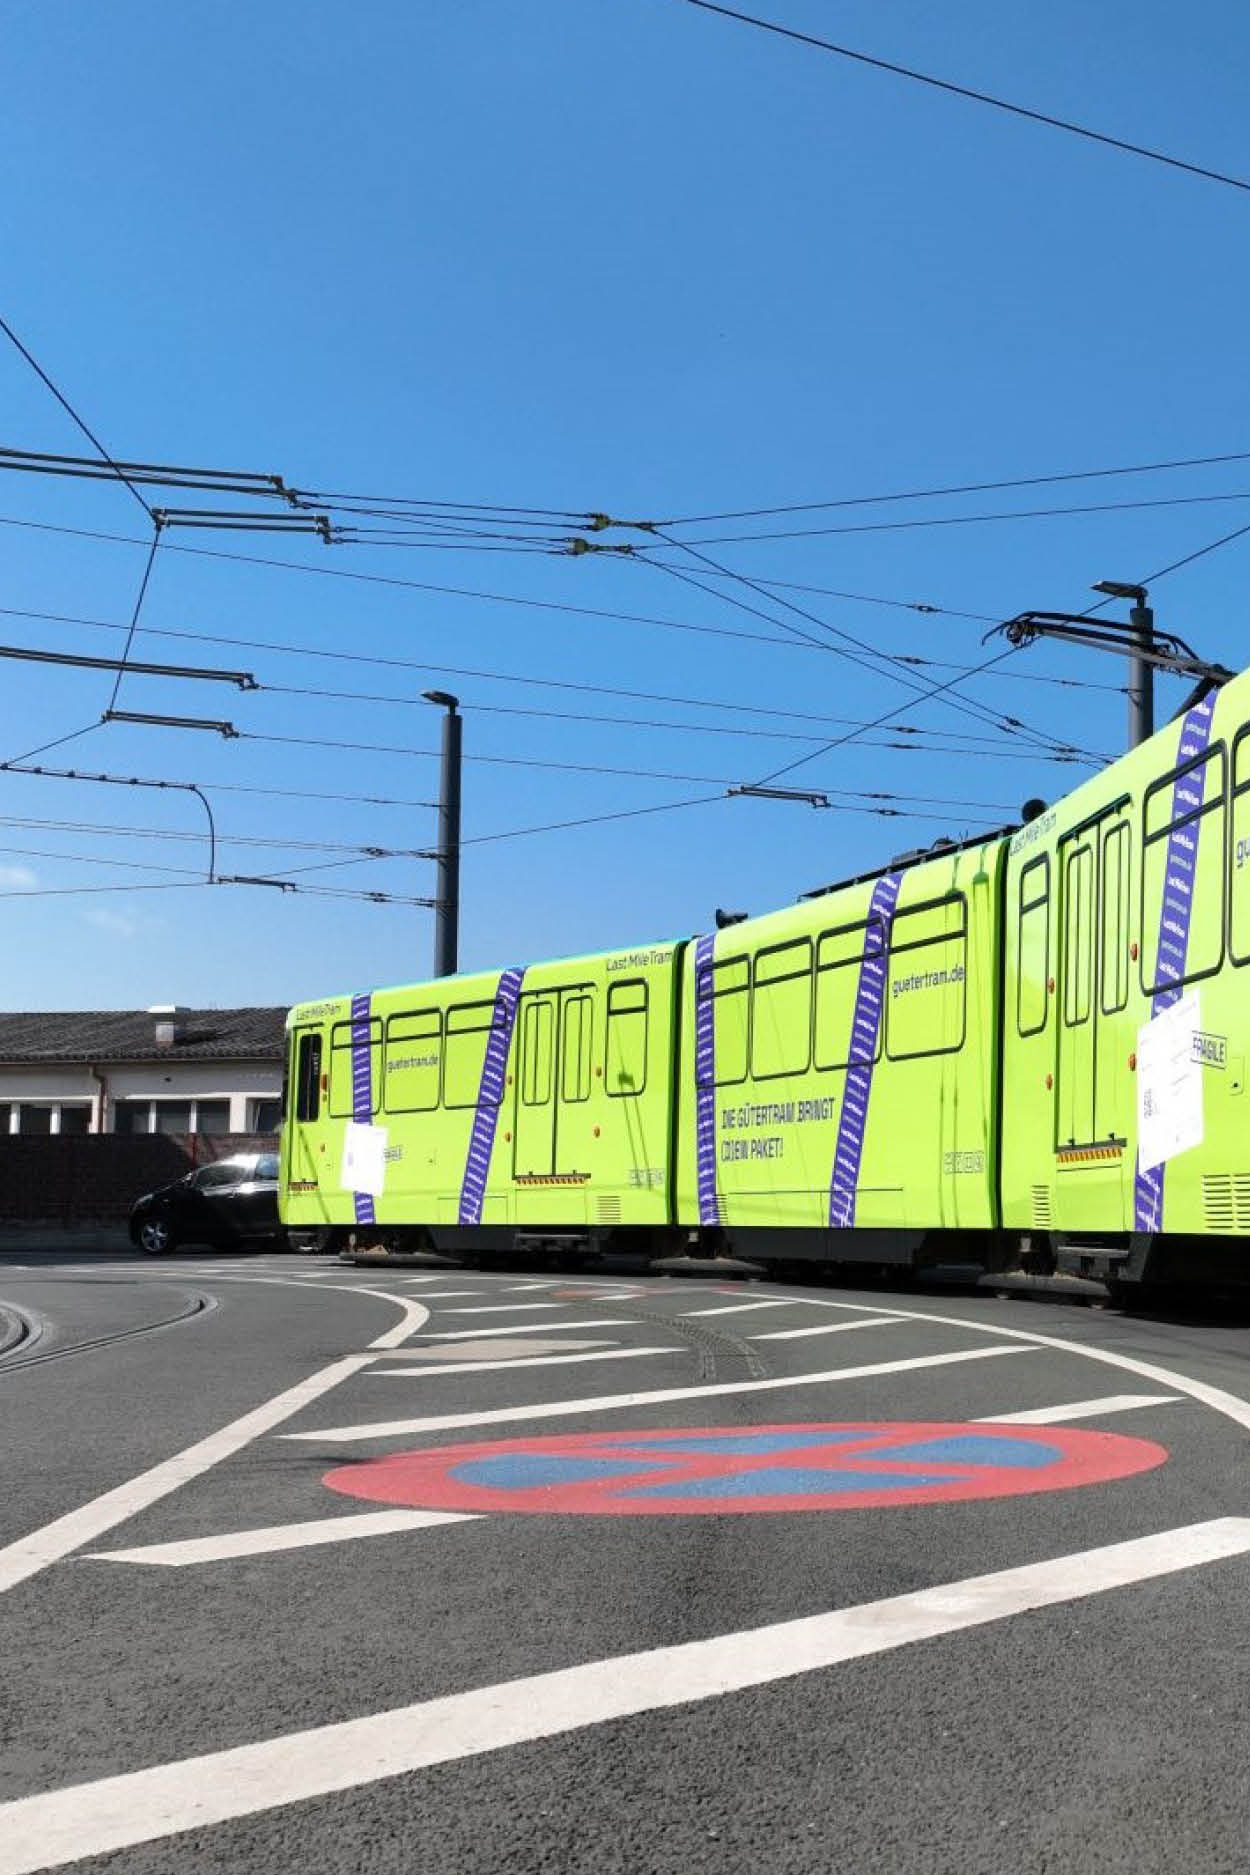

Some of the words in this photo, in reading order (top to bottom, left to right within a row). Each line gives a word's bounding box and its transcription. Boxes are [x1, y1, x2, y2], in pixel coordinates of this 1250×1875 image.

[893, 963, 965, 998] guetertram.de
[1192, 1036, 1225, 1064] FRAGILE
[738, 1102, 795, 1128] GÜTERTRAM
[798, 1097, 835, 1123] BRINGT
[750, 1137, 784, 1160] PAKET!
